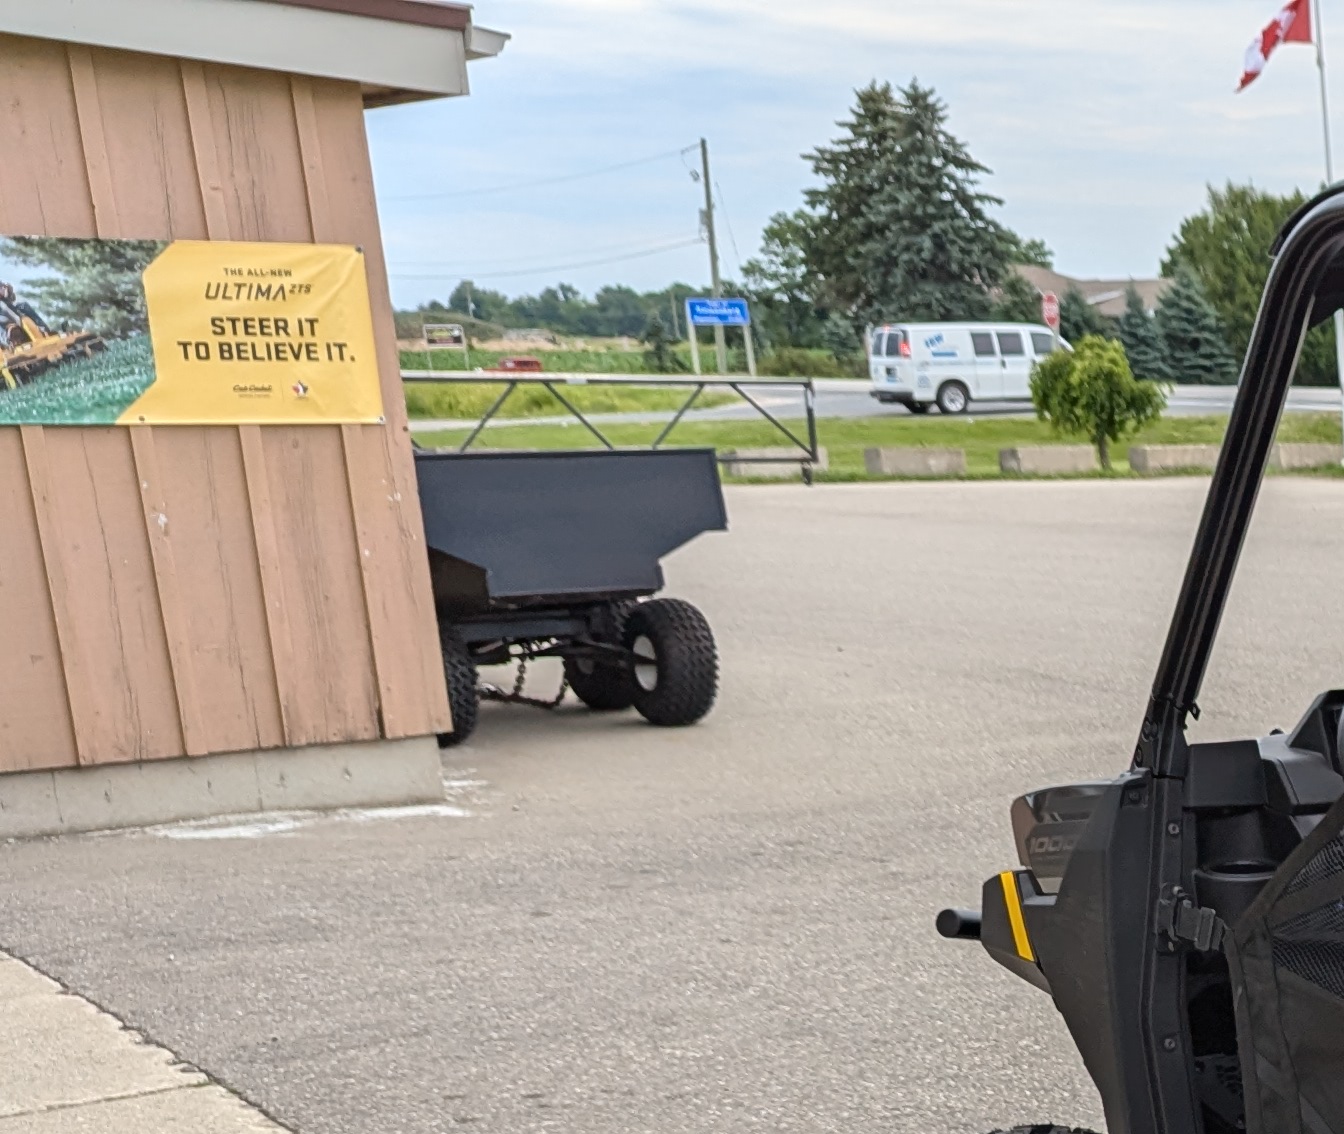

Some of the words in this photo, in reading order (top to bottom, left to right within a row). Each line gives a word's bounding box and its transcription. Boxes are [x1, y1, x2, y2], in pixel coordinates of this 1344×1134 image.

[223, 267, 243, 276] THE
[247, 268, 292, 277] ALL-NEW
[205, 282, 287, 301] ULTIMA
[211, 316, 291, 337] STEER
[297, 317, 319, 337] IT
[177, 341, 211, 361] TO
[218, 341, 320, 362] BELIEVE
[326, 342, 356, 362] IT.
